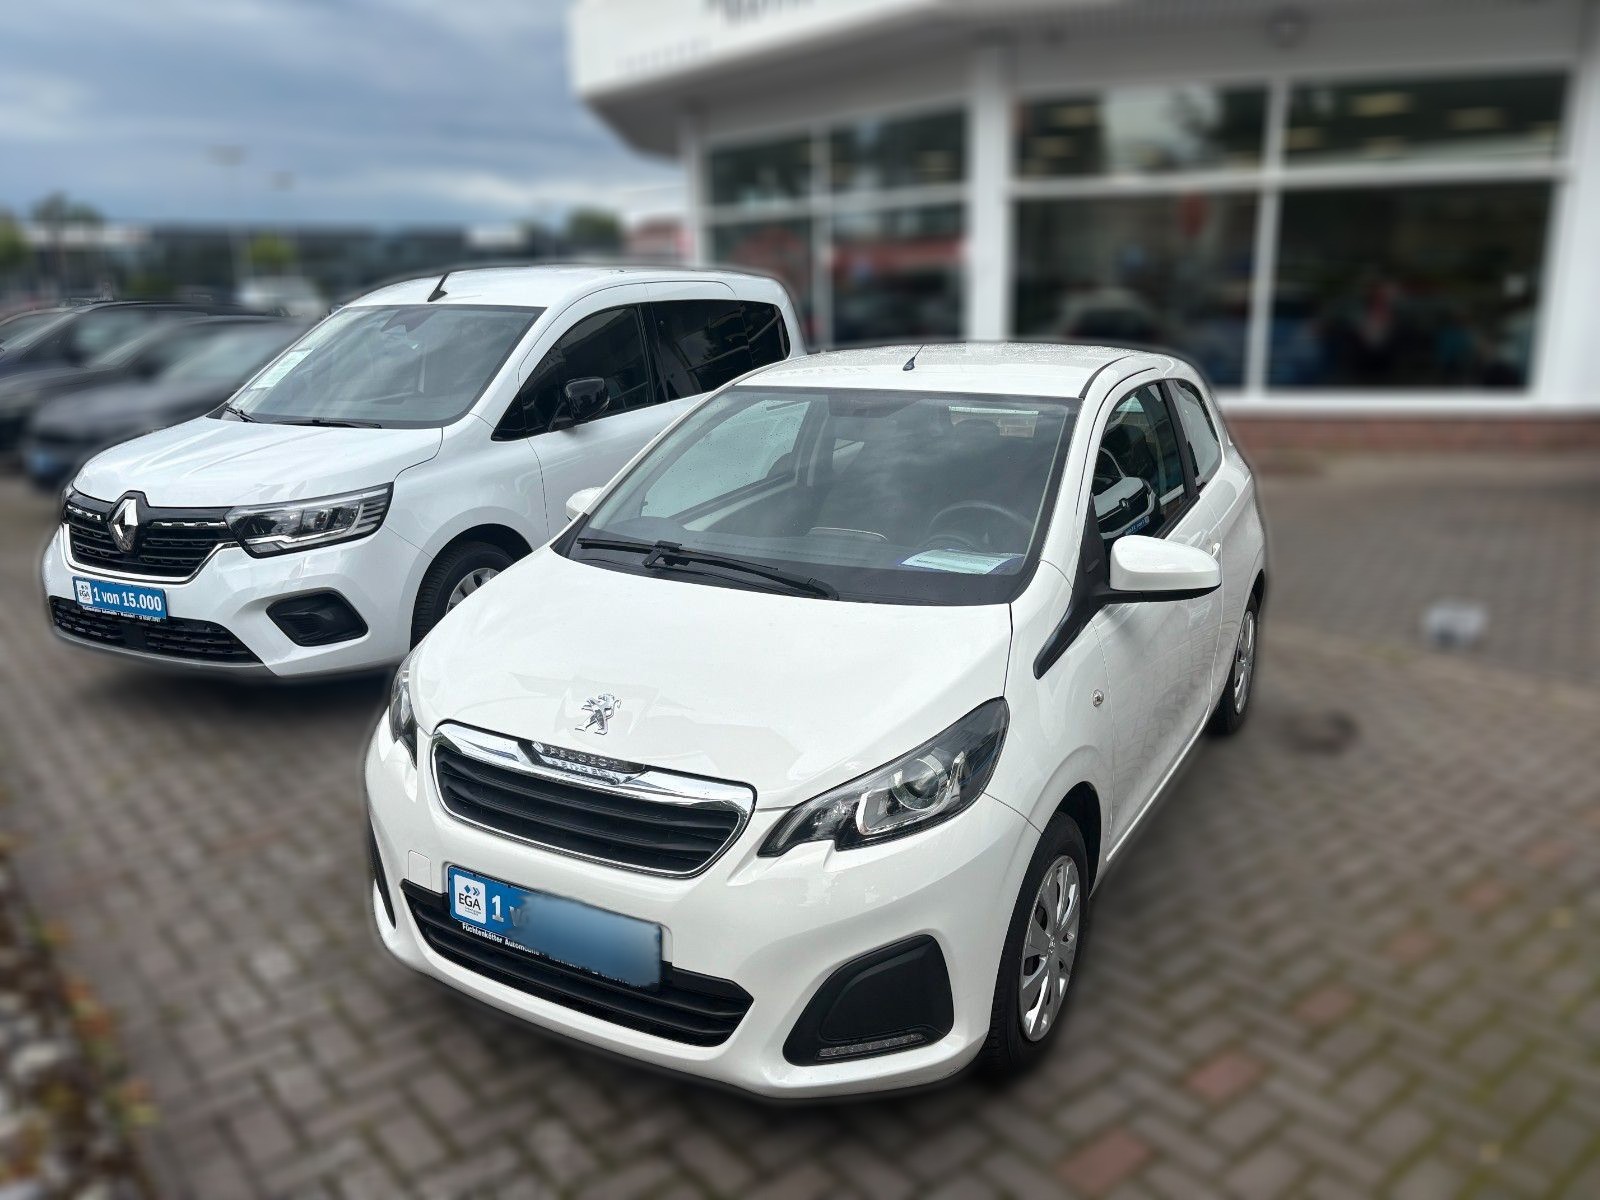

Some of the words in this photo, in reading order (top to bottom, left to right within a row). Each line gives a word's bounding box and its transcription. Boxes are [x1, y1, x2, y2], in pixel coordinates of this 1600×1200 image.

[93, 587, 101, 602] 1
[101, 591, 120, 605] von
[122, 591, 162, 612] 15.000
[458, 892, 482, 911] EGA
[491, 894, 504, 923] 1
